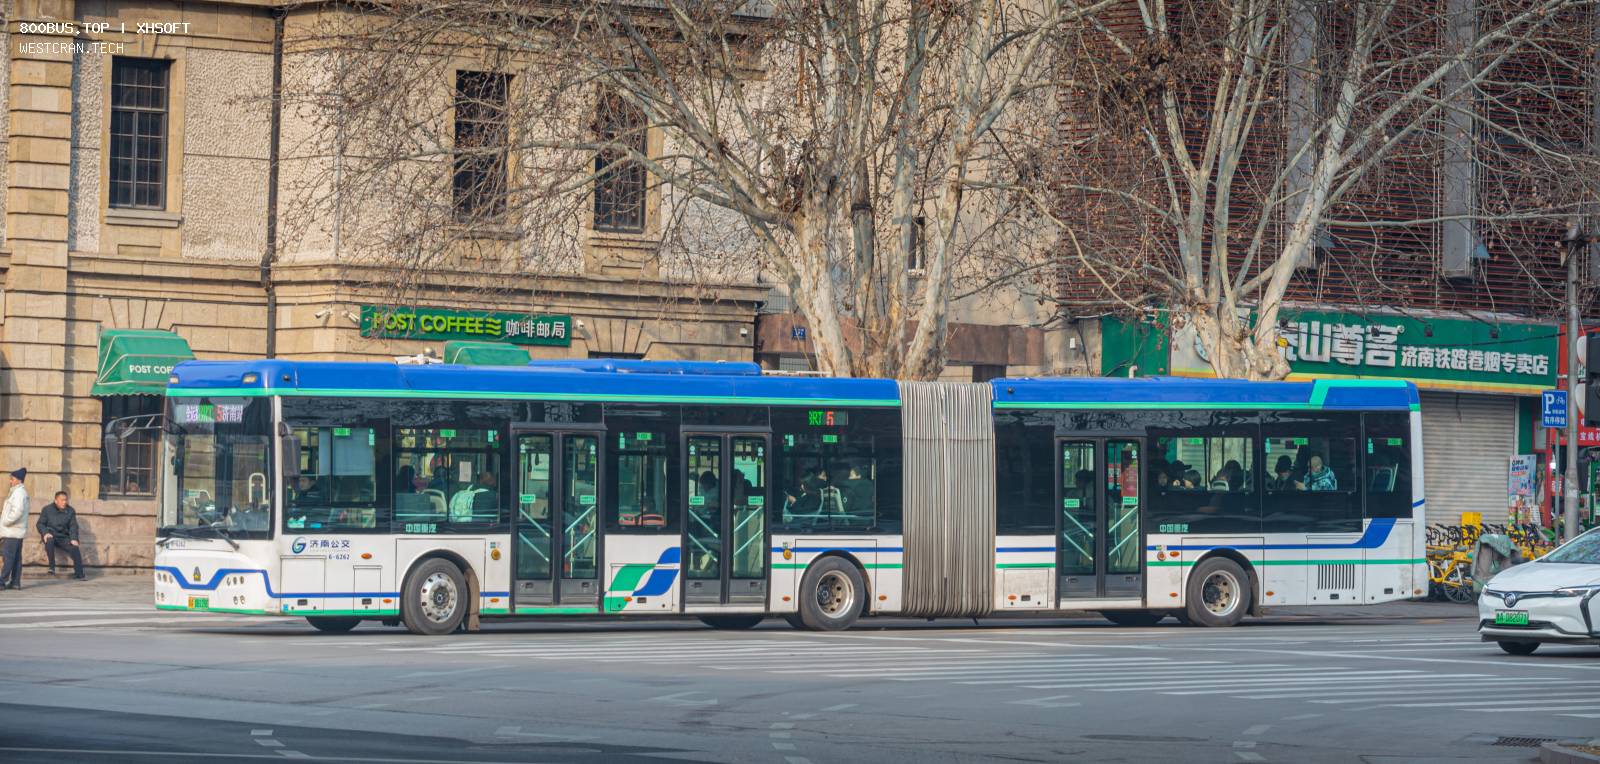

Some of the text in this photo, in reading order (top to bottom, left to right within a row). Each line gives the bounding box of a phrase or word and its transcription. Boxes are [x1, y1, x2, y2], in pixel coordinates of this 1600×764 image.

[372, 312, 484, 334] POST COFFEE
[505, 319, 566, 339] 咖啡邮局
[129, 364, 152, 374] POST
[1401, 345, 1549, 376] 济南铁路卷烟专卖店
[1544, 393, 1555, 415] P
[825, 411, 834, 426] 5
[310, 539, 350, 548] 济南公交
